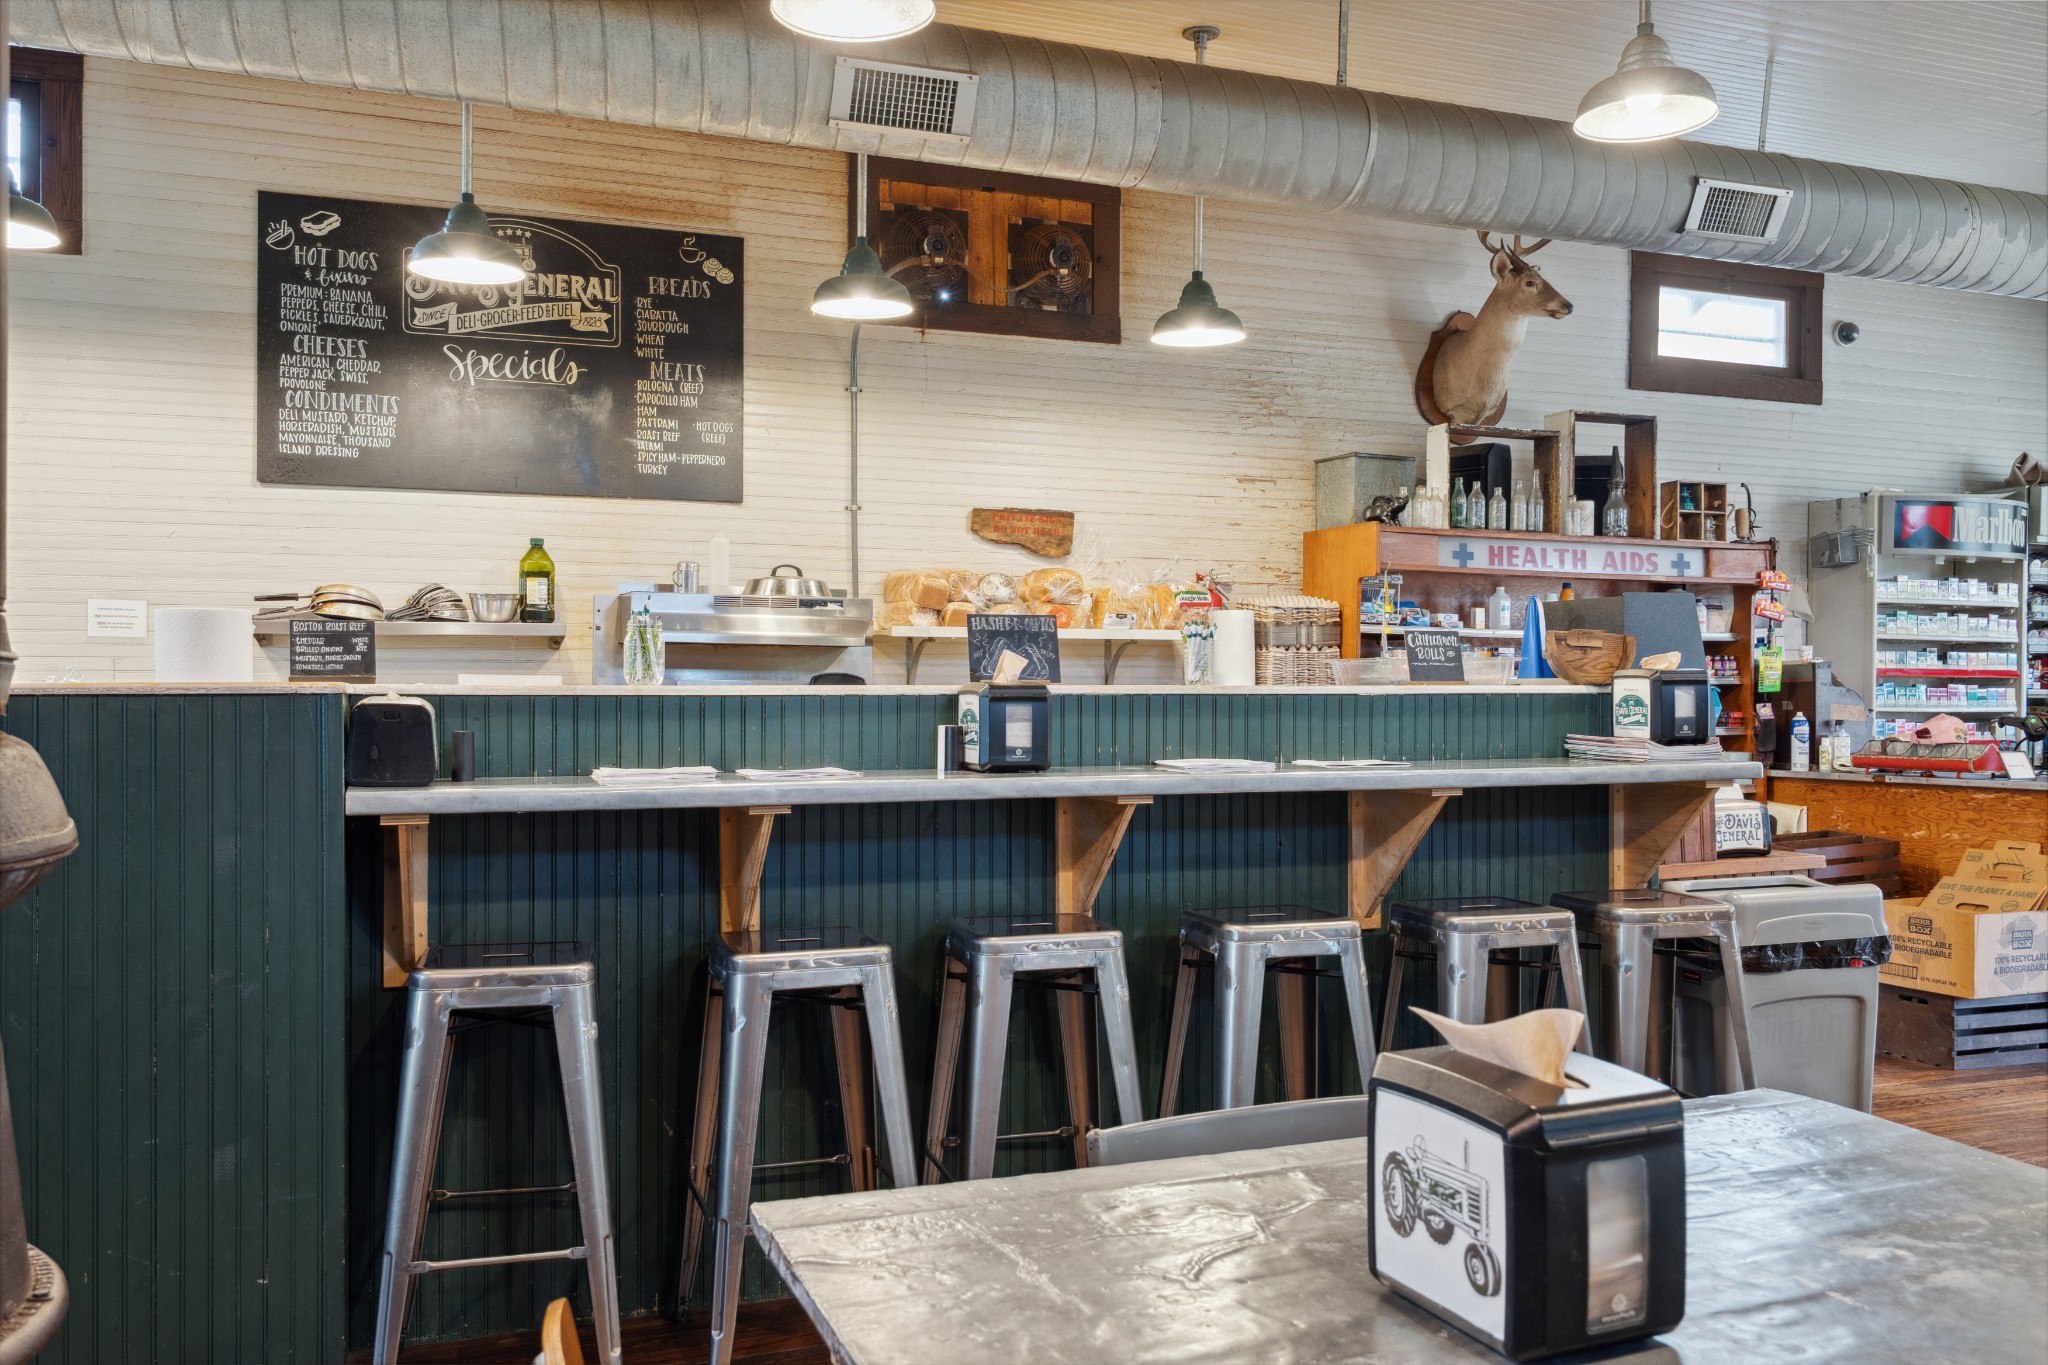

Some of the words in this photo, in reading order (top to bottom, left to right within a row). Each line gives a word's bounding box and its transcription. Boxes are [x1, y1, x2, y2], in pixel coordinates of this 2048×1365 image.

[294, 245, 331, 267] HOT
[338, 249, 379, 271] DOGS
[304, 268, 313, 281] &
[503, 271, 620, 311] GENERAL
[648, 276, 711, 298] BREADS
[330, 288, 373, 305] BANANA
[636, 297, 653, 309] RYE
[418, 308, 447, 324] SINCE
[551, 303, 576, 317] FUEL
[582, 317, 603, 328] 1928
[636, 309, 679, 321] CIABATTA
[280, 321, 317, 334] ONIONS
[637, 320, 689, 334] SOURDOUGH
[293, 334, 368, 359] CHEESES
[636, 334, 666, 345] WHEAT
[636, 347, 665, 360] WHITE
[443, 344, 588, 386] Specials
[650, 361, 706, 382] MEATS
[279, 366, 310, 379] PEPPER
[279, 377, 327, 391] PROVOLONE
[637, 380, 675, 393] BOLOGNA
[680, 382, 704, 394] (BEEF)
[285, 390, 400, 414] CONDIMENTS
[637, 393, 678, 406] CAPOCOLLO
[680, 395, 698, 408] HAM
[279, 409, 299, 421] DELI
[637, 406, 657, 416] HAM
[637, 418, 679, 430] PASTRAMI
[696, 421, 711, 432] HOT
[713, 422, 734, 433] DOGS
[342, 436, 391, 448] THOUSAND
[637, 430, 660, 441] ROAST
[662, 431, 681, 442] BEEF
[702, 432, 726, 445] (BEEF)
[279, 443, 312, 455] ISLAND
[315, 446, 360, 459] DRESSING
[637, 440, 664, 451] SALAMI
[637, 451, 657, 462] SPICY
[637, 463, 668, 475] TURKEY
[991, 511, 1035, 523] PRIVATE
[1952, 505, 2026, 548] Marlboro
[1488, 544, 1587, 570] HEALTH
[1602, 550, 1659, 574] AIDS
[293, 621, 323, 632] BOSTON
[325, 622, 347, 631] ROAST
[349, 621, 367, 631] BEEF
[970, 616, 1056, 632] HASHBROWNS
[296, 637, 325, 645] CHEDDAR
[1407, 631, 1460, 648] Cinnamon
[1415, 646, 1445, 661] ROLLS
[1724, 813, 1761, 830] DAVIS
[1716, 829, 1761, 849] GENERAL
[1939, 882, 1956, 891] GIVE
[1957, 884, 1975, 892] THE
[1973, 886, 2007, 896] PLANET
[2005, 889, 2014, 897] A
[2012, 890, 2038, 899] HAND
[1909, 925, 1932, 935] BOX
[1907, 937, 1953, 951] RECYCLABLE
[2013, 940, 2033, 949] BOX
[1894, 943, 1953, 960] BIODEGRADABLE
[1994, 955, 2010, 964] 100%
